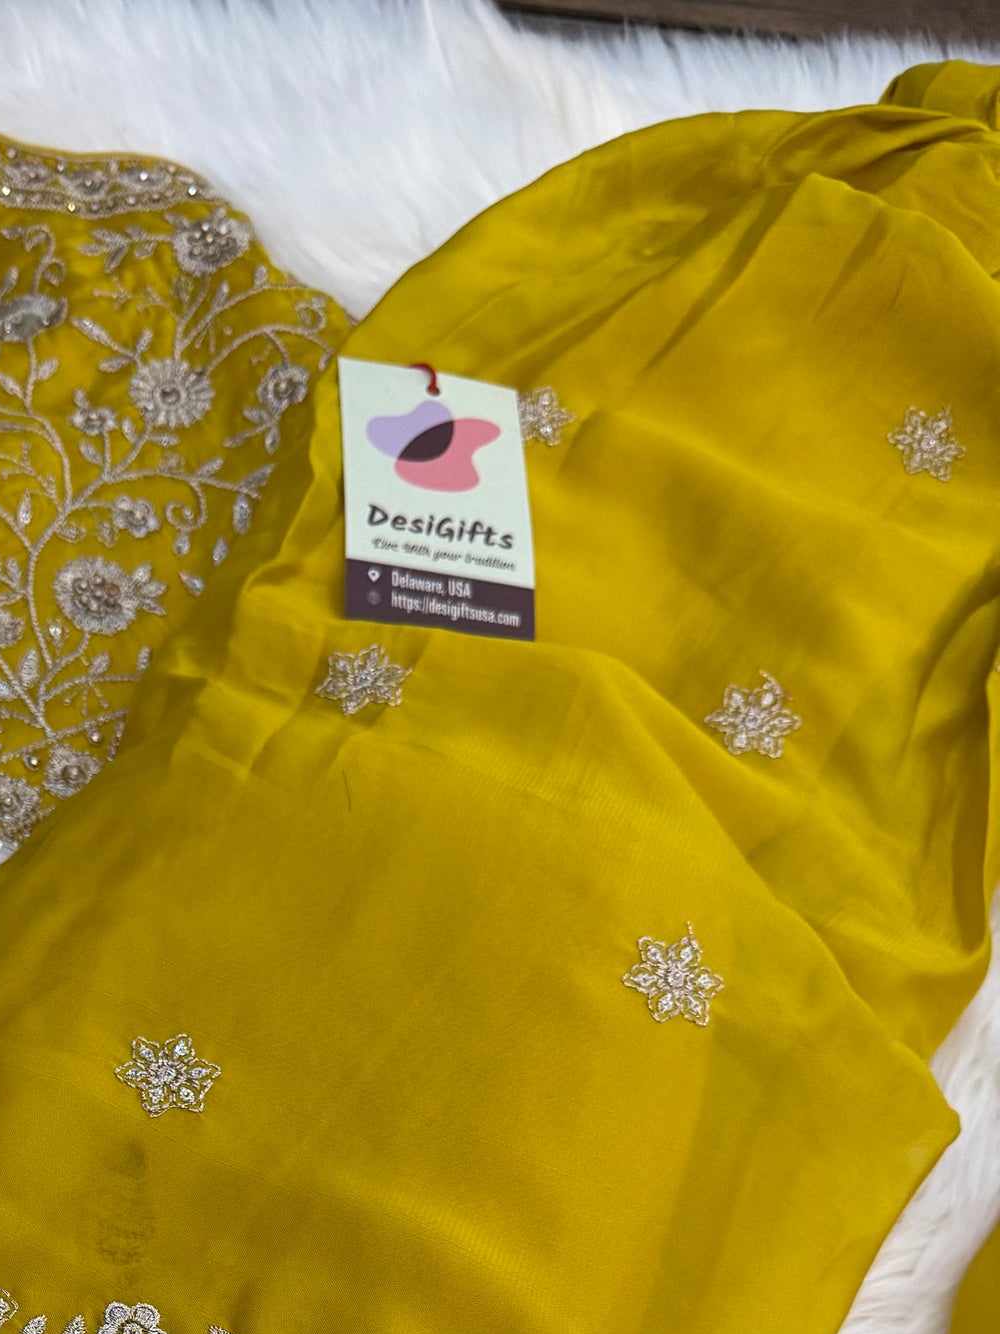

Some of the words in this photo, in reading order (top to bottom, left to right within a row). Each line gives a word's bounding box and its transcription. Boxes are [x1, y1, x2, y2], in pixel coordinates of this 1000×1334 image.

[367, 504, 514, 550] DesiGifts
[432, 549, 462, 562] your
[391, 571, 445, 595] Delaware,
[448, 581, 471, 599] USA
[391, 593, 520, 627] https://desigiftsusa.com
